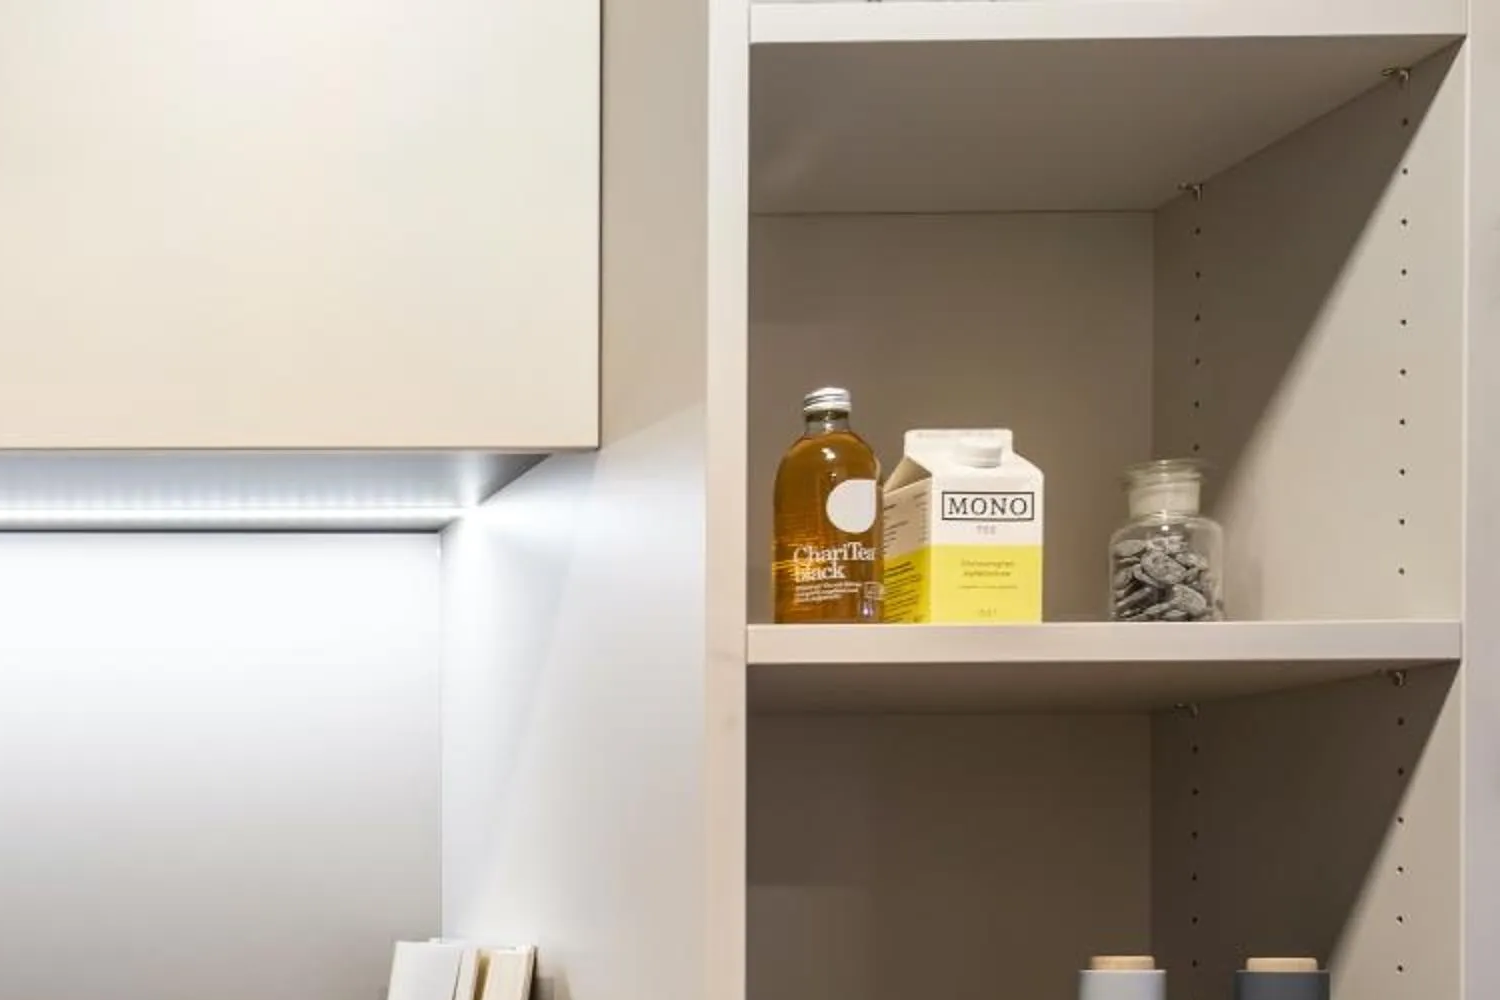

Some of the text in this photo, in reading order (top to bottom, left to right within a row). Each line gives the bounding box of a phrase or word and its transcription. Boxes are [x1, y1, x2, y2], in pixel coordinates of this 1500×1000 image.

[948, 497, 1028, 516] MONO
[793, 541, 876, 562] ChariTea
[794, 560, 846, 582] black
